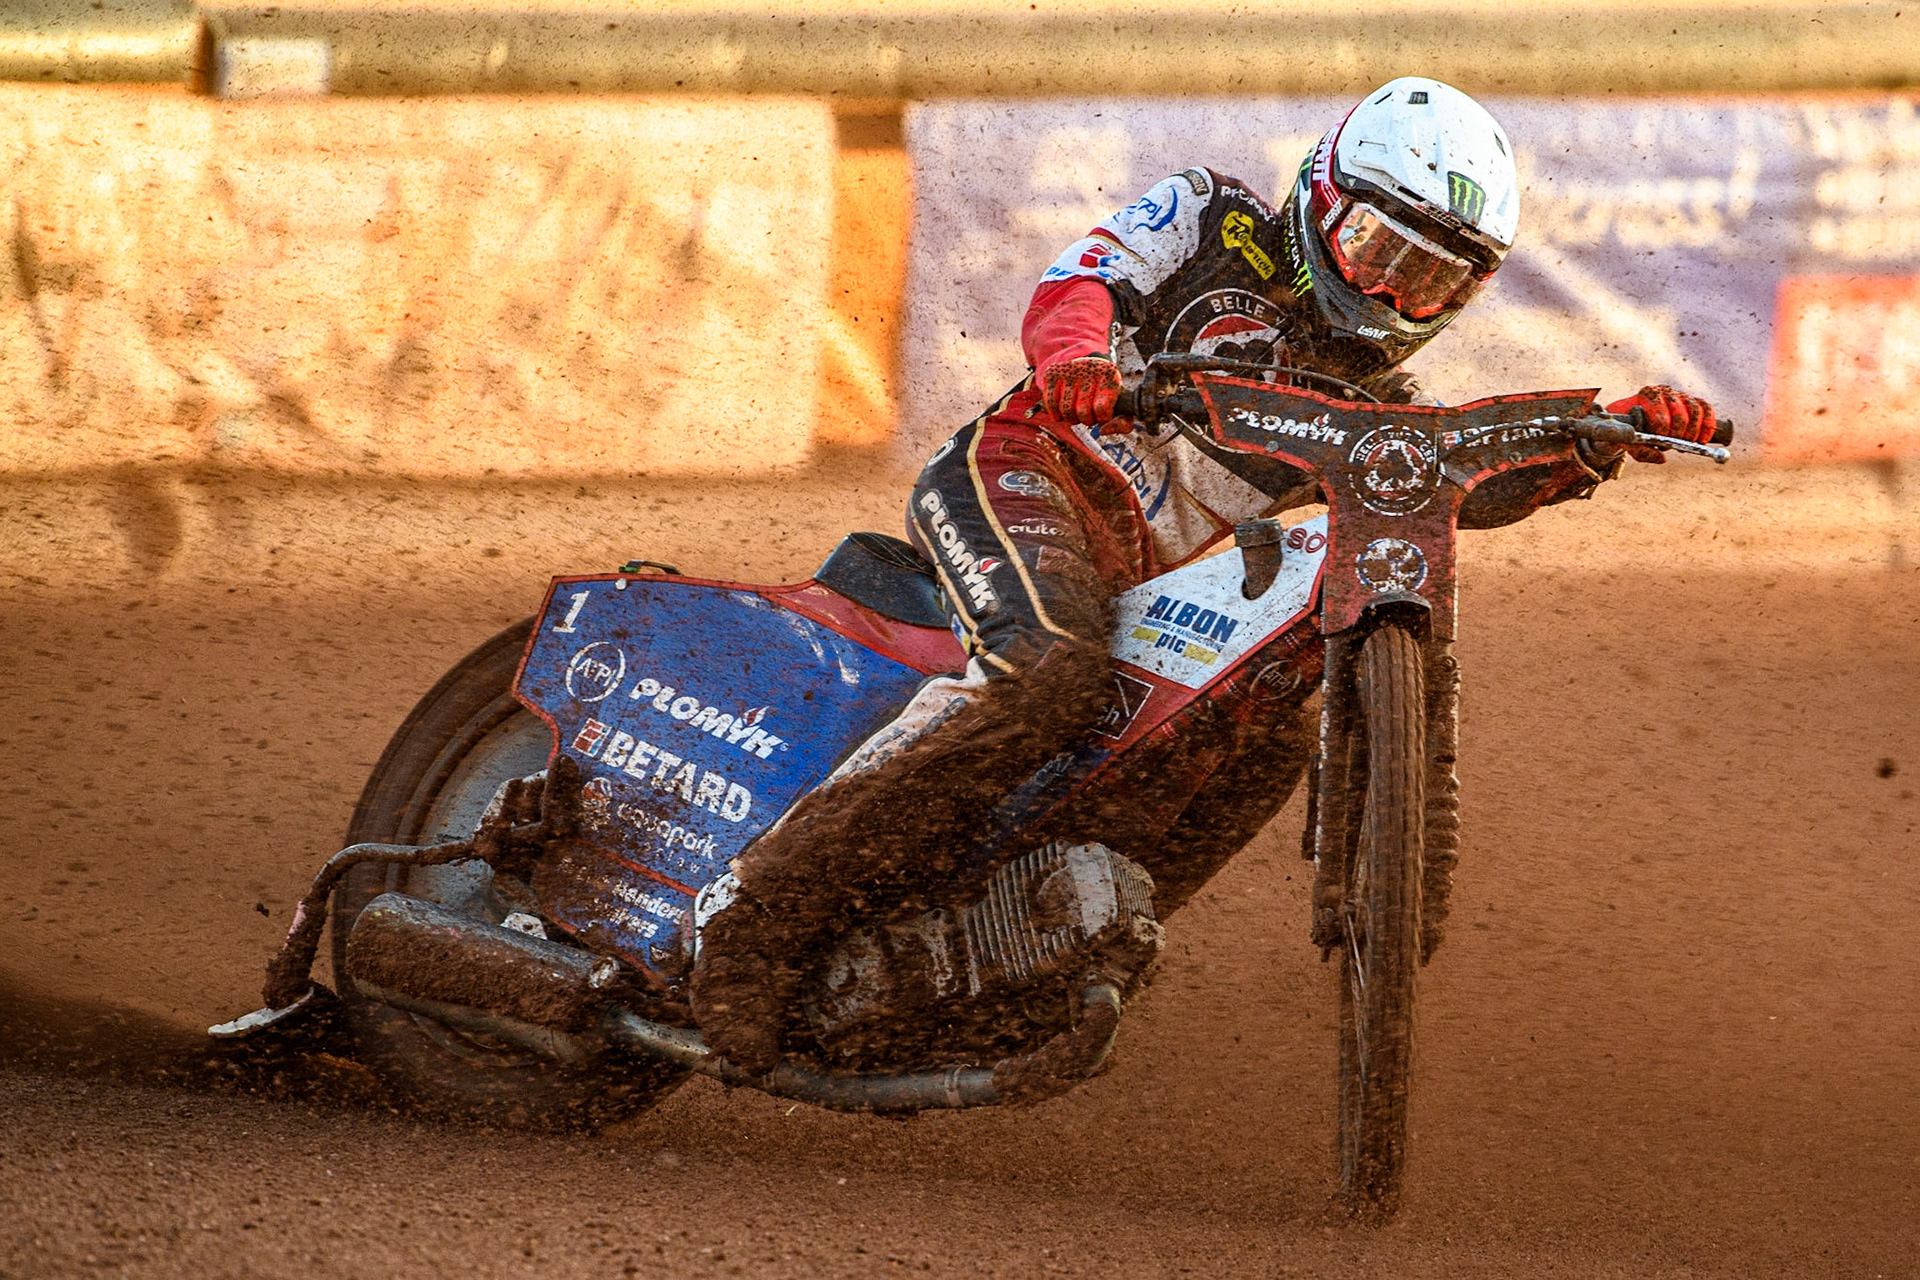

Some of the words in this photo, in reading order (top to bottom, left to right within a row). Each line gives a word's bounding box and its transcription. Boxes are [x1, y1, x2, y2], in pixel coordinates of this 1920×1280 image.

[1211, 296, 1265, 318] BELLE
[552, 590, 590, 633] 1
[1145, 594, 1239, 643] ALBON
[600, 730, 753, 823] BETARD
